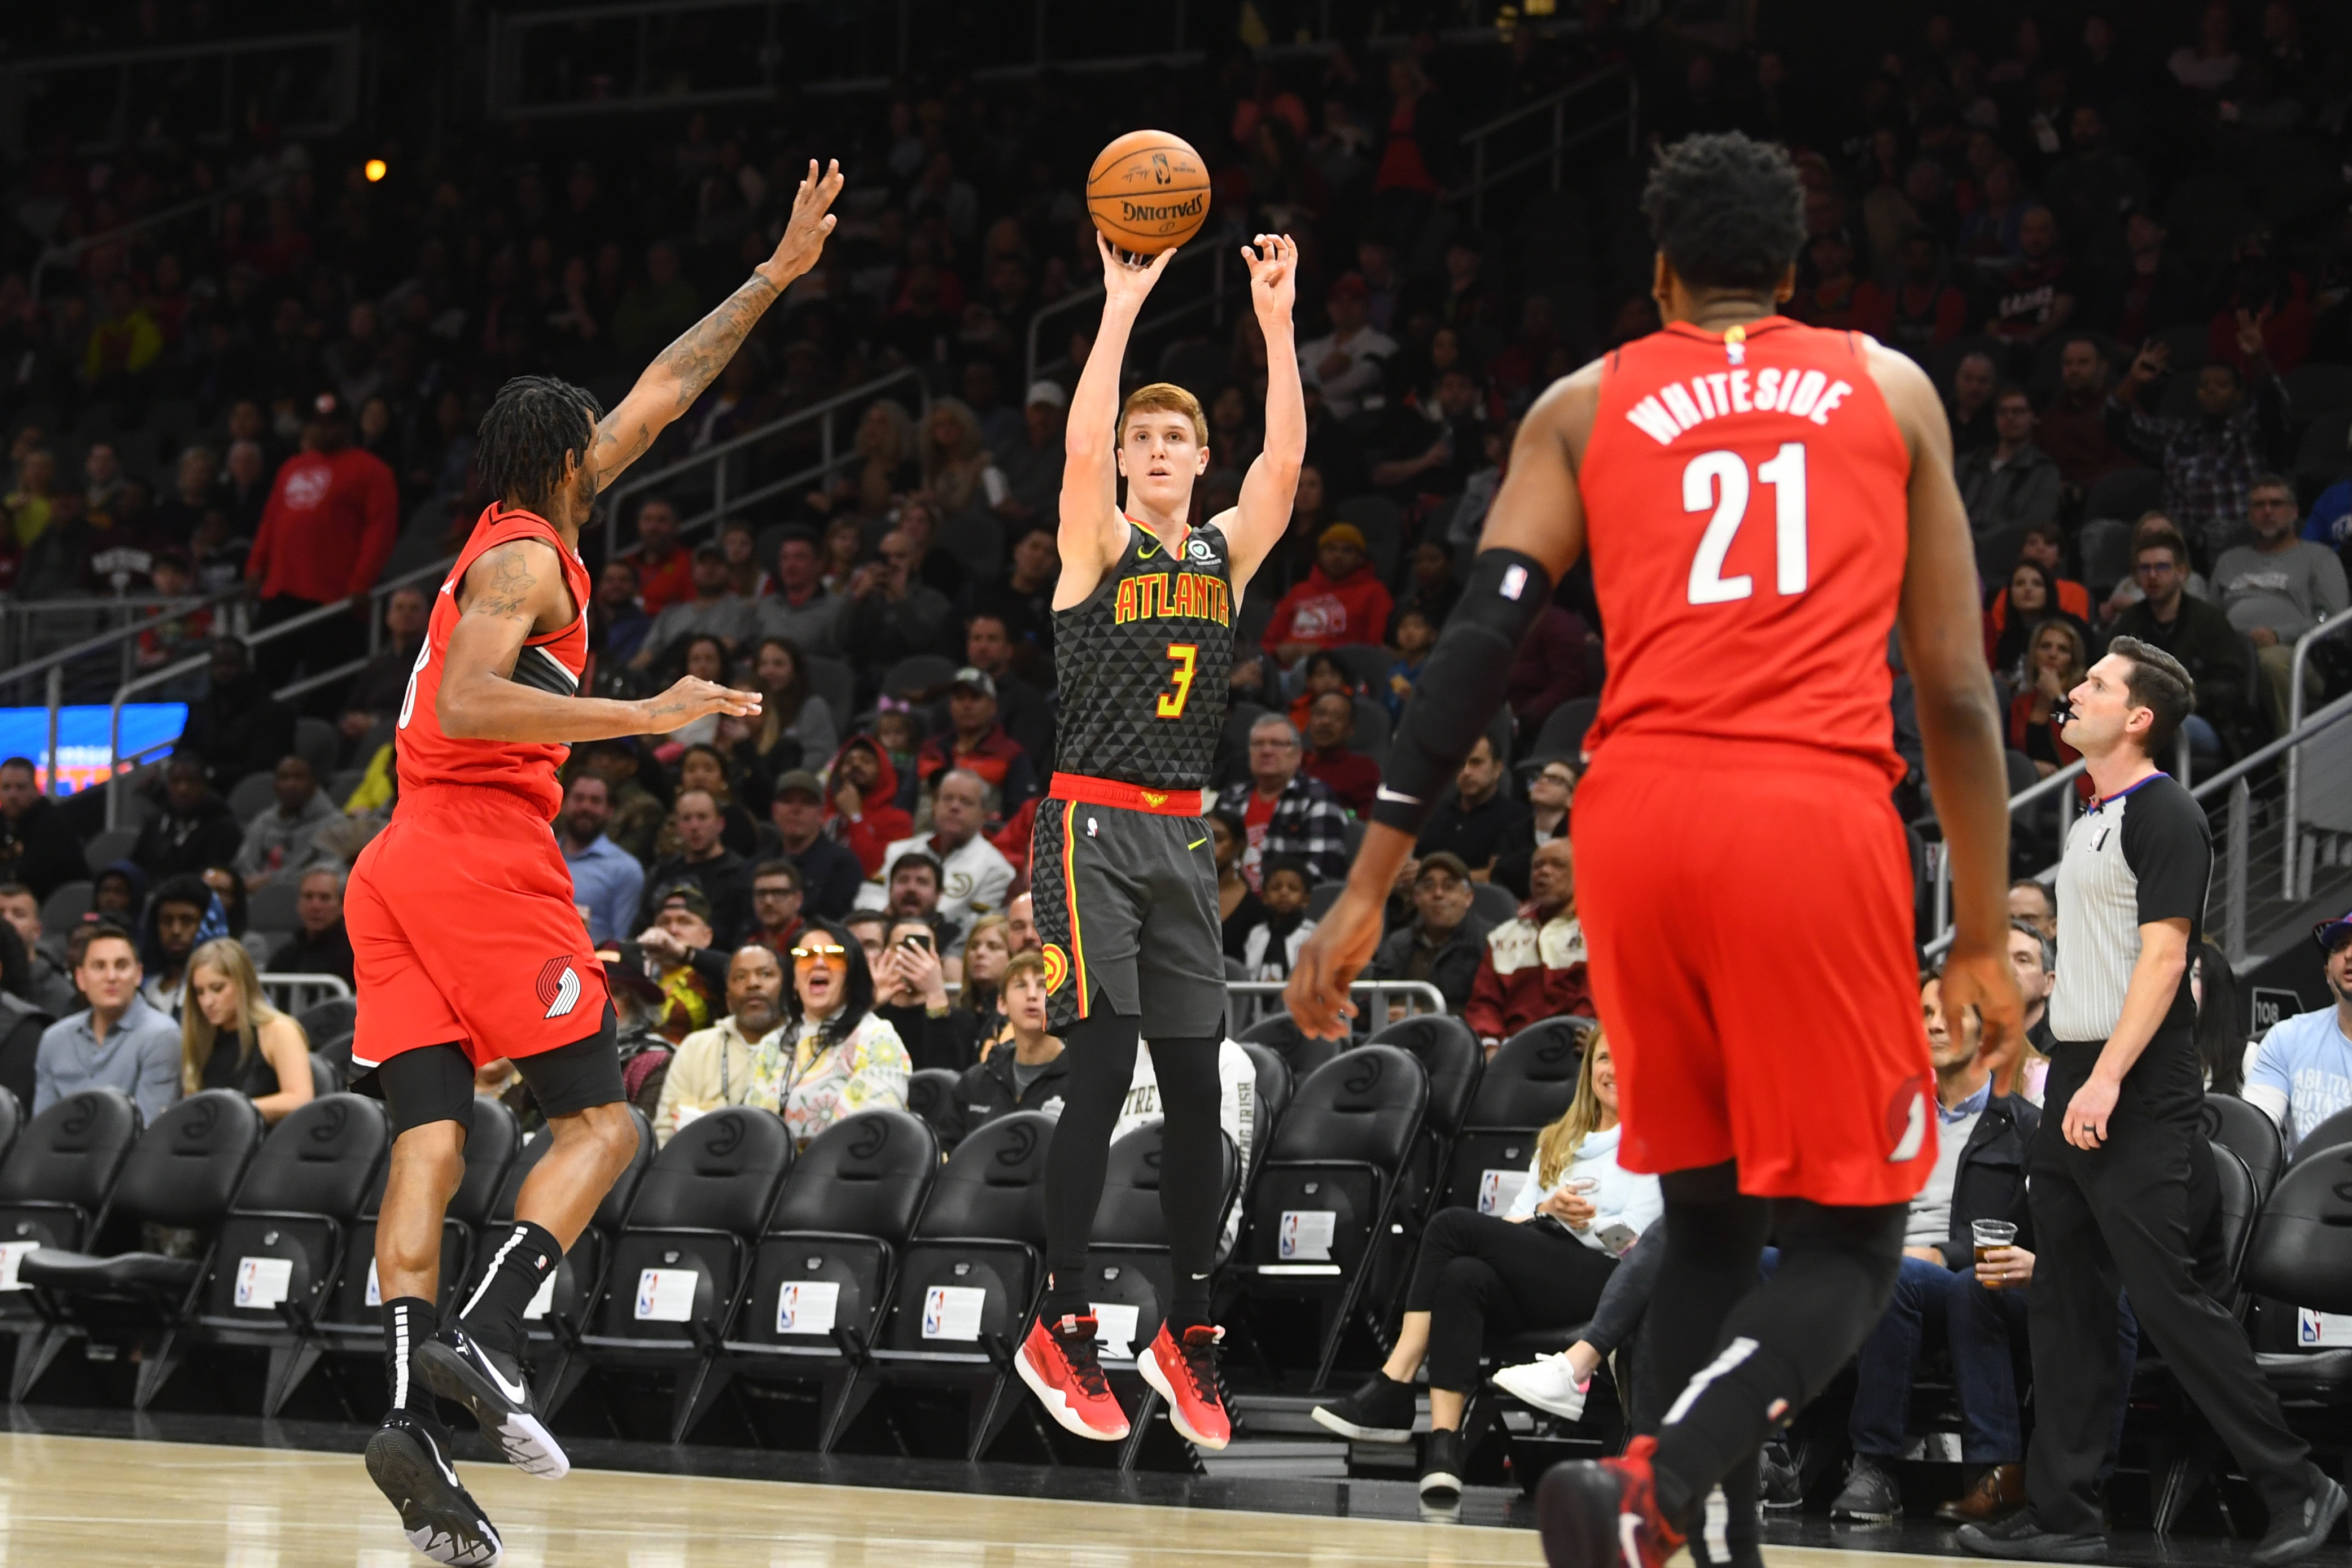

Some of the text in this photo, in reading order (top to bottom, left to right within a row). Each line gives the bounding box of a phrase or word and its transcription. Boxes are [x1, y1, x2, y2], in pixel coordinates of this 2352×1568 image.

[1122, 193, 1203, 221] SPALDING
[1626, 367, 1853, 446] WHITESIDE
[1681, 441, 1808, 606] 21
[1114, 572, 1229, 628] ATLANTA
[1155, 643, 1198, 719] 3
[2257, 1001, 2279, 1024] 108
[1121, 1084, 1156, 1117] TRE
[1237, 1082, 1253, 1124] IRISH
